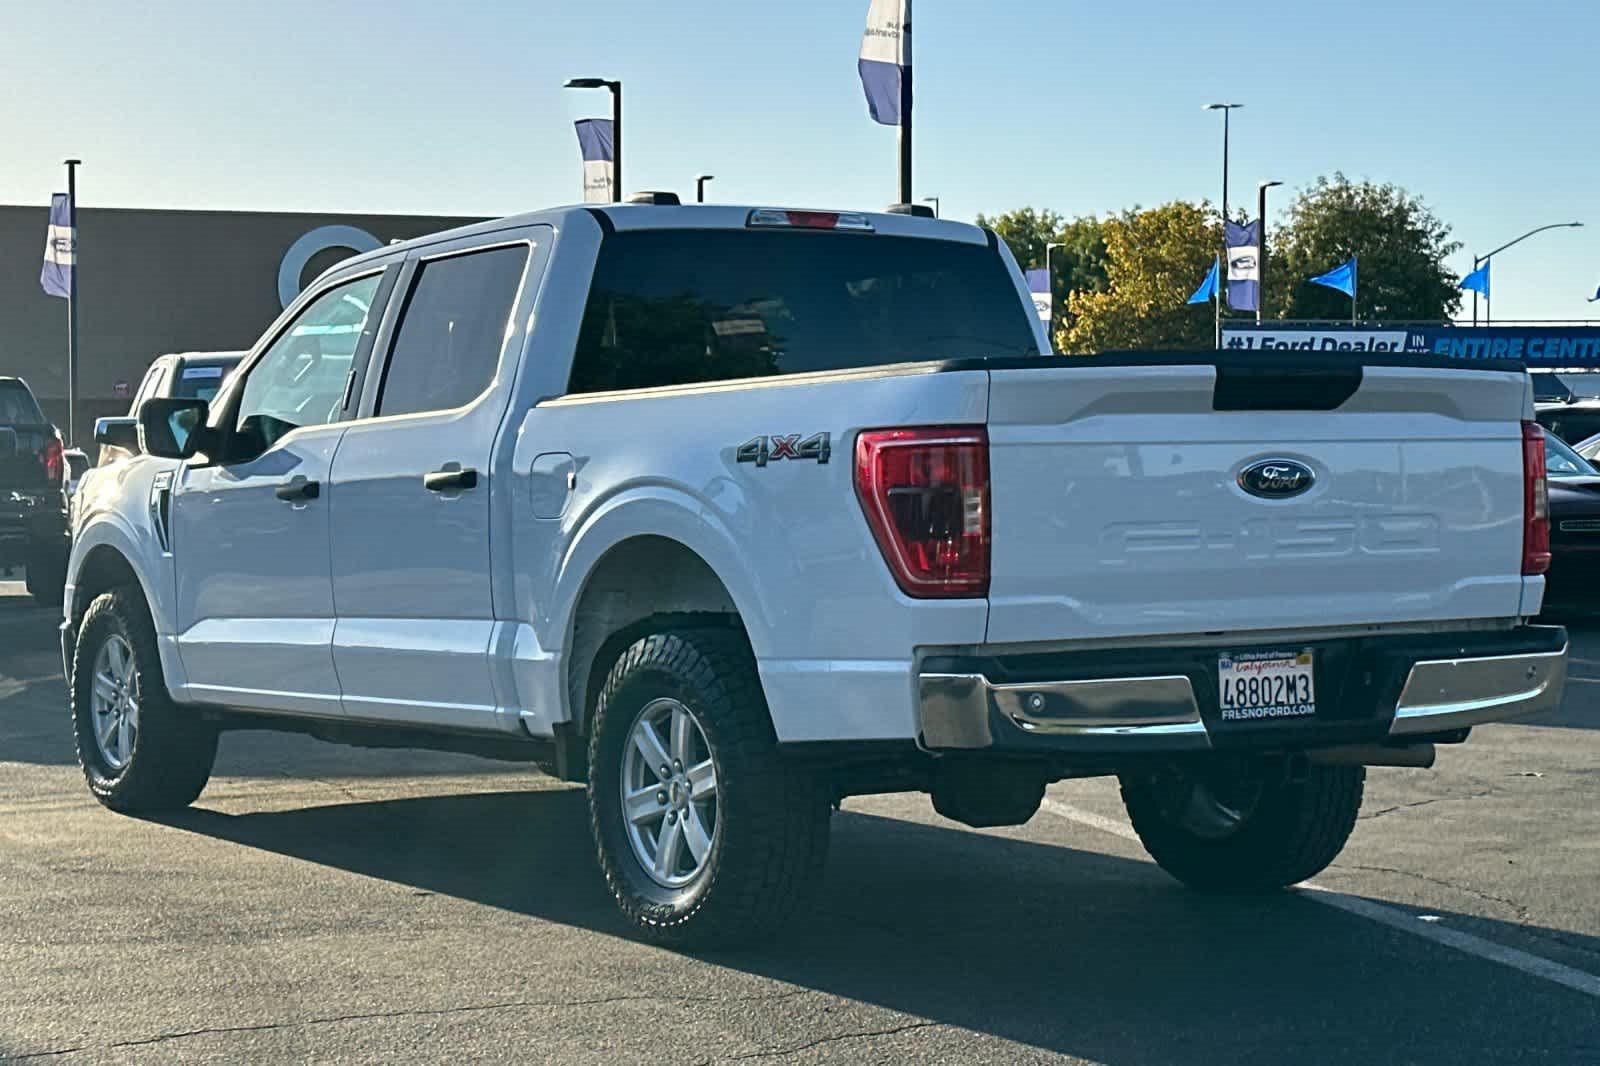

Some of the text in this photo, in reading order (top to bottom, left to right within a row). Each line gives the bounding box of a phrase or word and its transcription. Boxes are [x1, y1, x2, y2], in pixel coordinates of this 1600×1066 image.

[1260, 336, 1316, 350] Ford
[1320, 336, 1399, 352] Dealer
[1412, 335, 1425, 347] IN
[1434, 337, 1524, 359] ENTIRE
[1257, 464, 1301, 489] Ford
[1235, 660, 1297, 675] California
[1223, 674, 1310, 707] 48802M3
[1221, 704, 1315, 720] FRESNOFORD.COM
